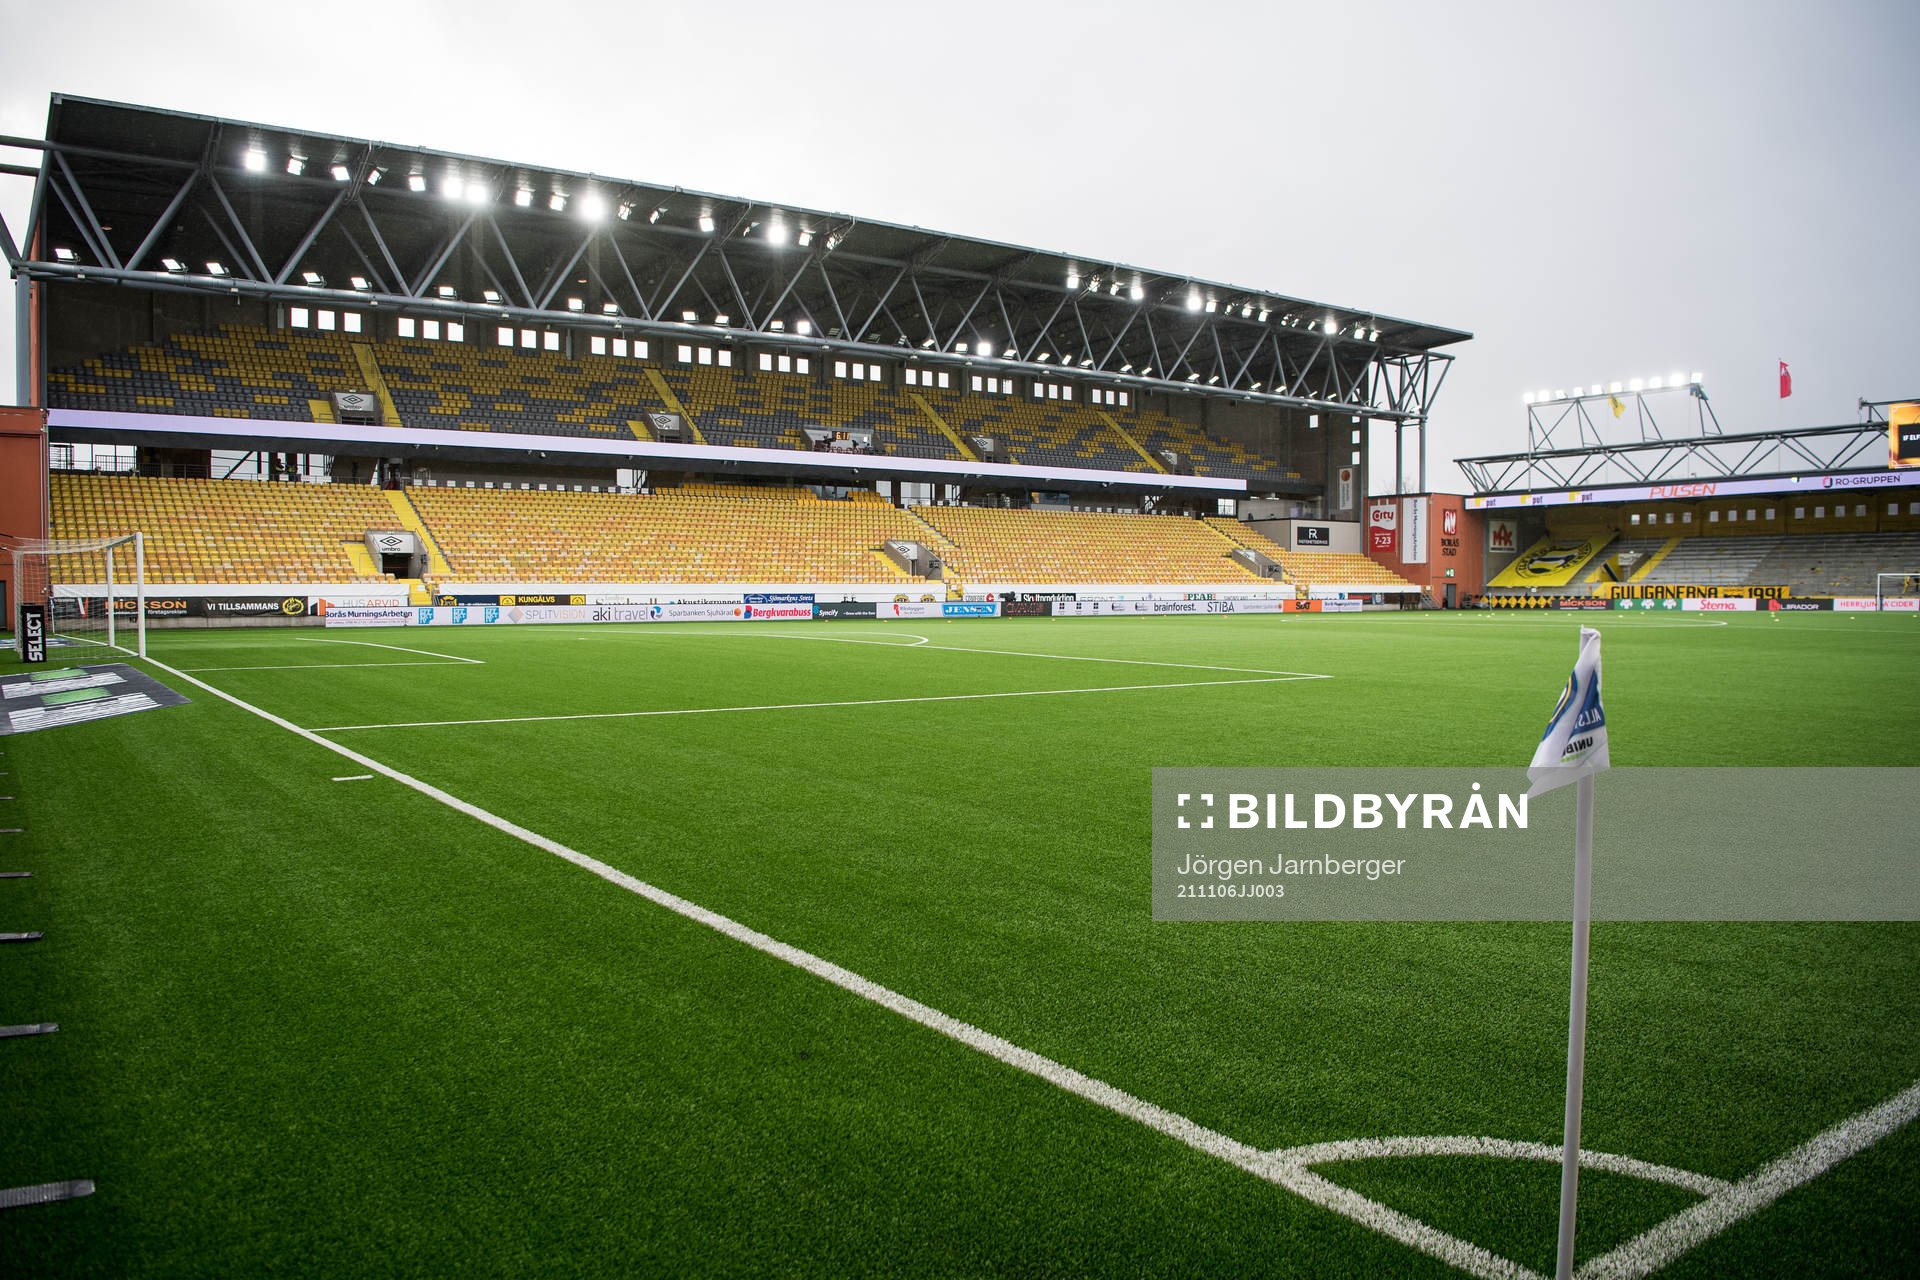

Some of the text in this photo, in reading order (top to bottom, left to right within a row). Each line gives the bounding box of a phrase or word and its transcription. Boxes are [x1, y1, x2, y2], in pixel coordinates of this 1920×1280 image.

[1836, 475, 1901, 486] RO-GRUPPEN
[1648, 482, 1717, 500] PULSEN
[1375, 536, 1392, 545] 7-23
[1187, 593, 1214, 601] PEAB
[1748, 587, 1783, 599] 1991
[218, 602, 279, 611] TILLSAMMANS
[945, 605, 993, 614] JENSEN
[1153, 602, 1197, 612] brainforest.
[1206, 601, 1235, 612] STIBA
[525, 608, 586, 620] SPLITVISION
[592, 607, 649, 621] aki travel
[669, 609, 706, 619] Sparbanken
[753, 607, 812, 619] Bergkvarabuss
[26, 613, 43, 661] SELECT
